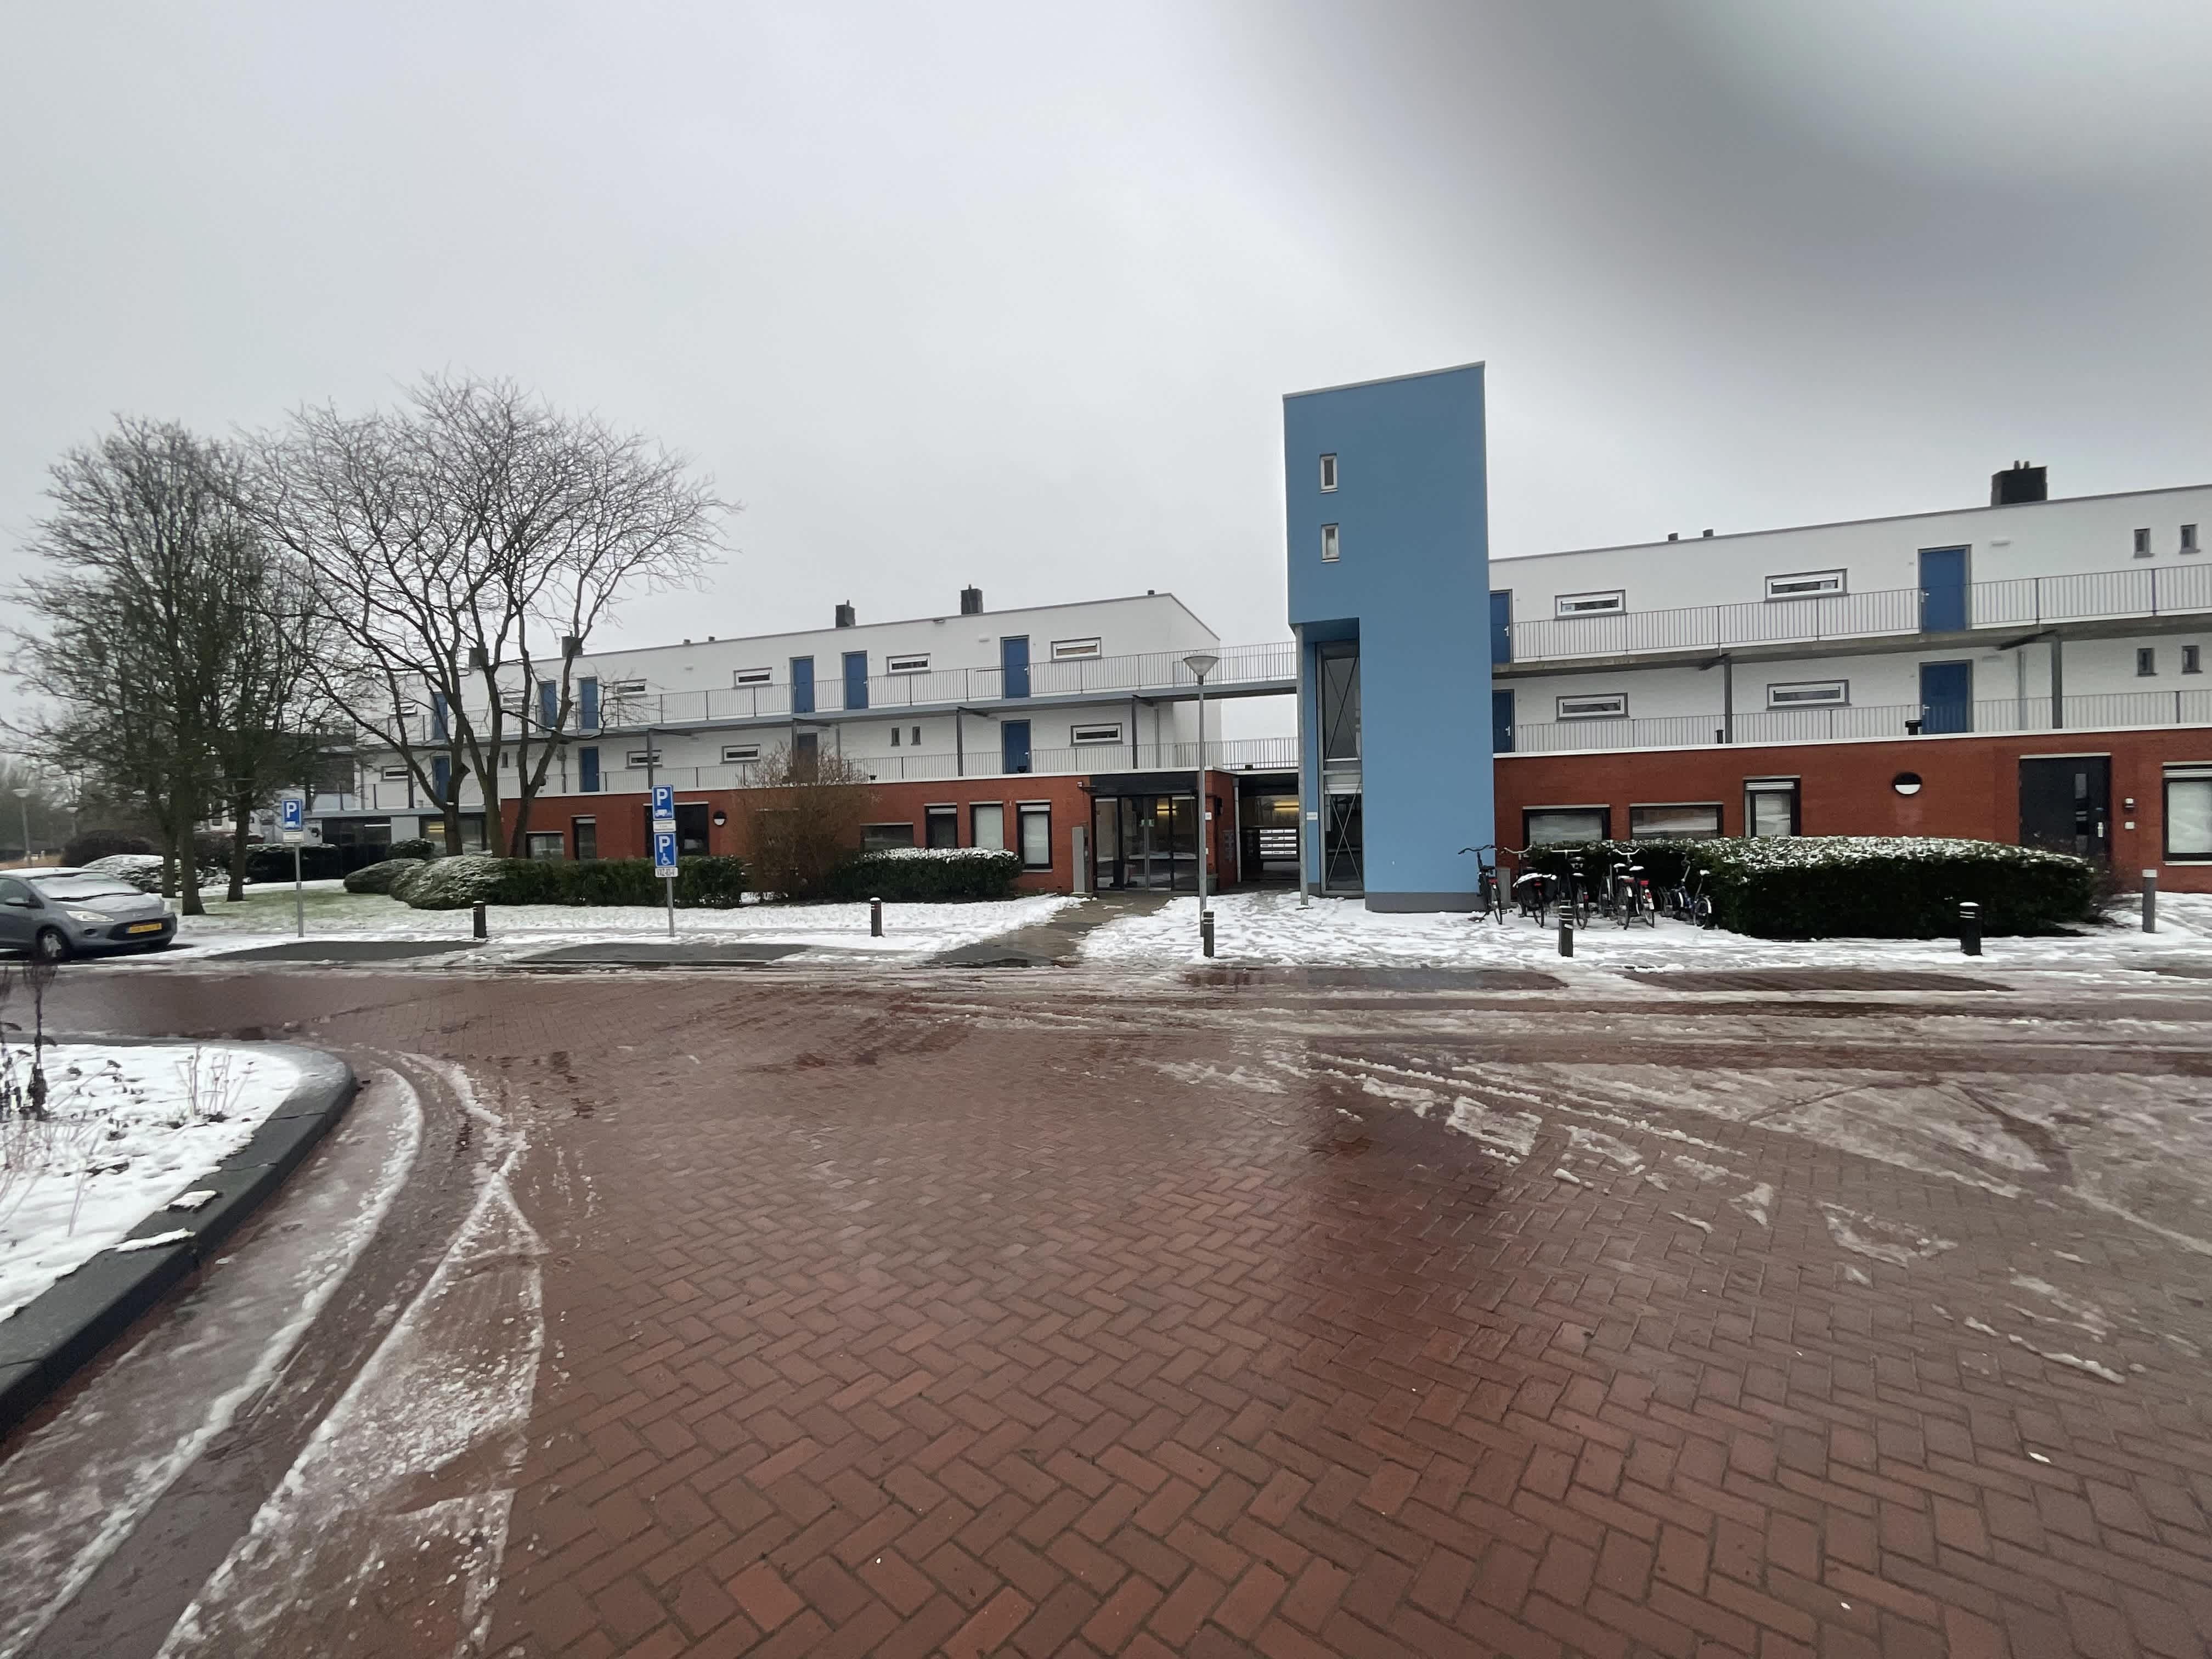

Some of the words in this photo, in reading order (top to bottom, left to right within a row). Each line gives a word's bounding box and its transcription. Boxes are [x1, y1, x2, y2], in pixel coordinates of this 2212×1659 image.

[657, 788, 668, 806] P
[286, 802, 297, 818] P
[659, 836, 670, 853] P
